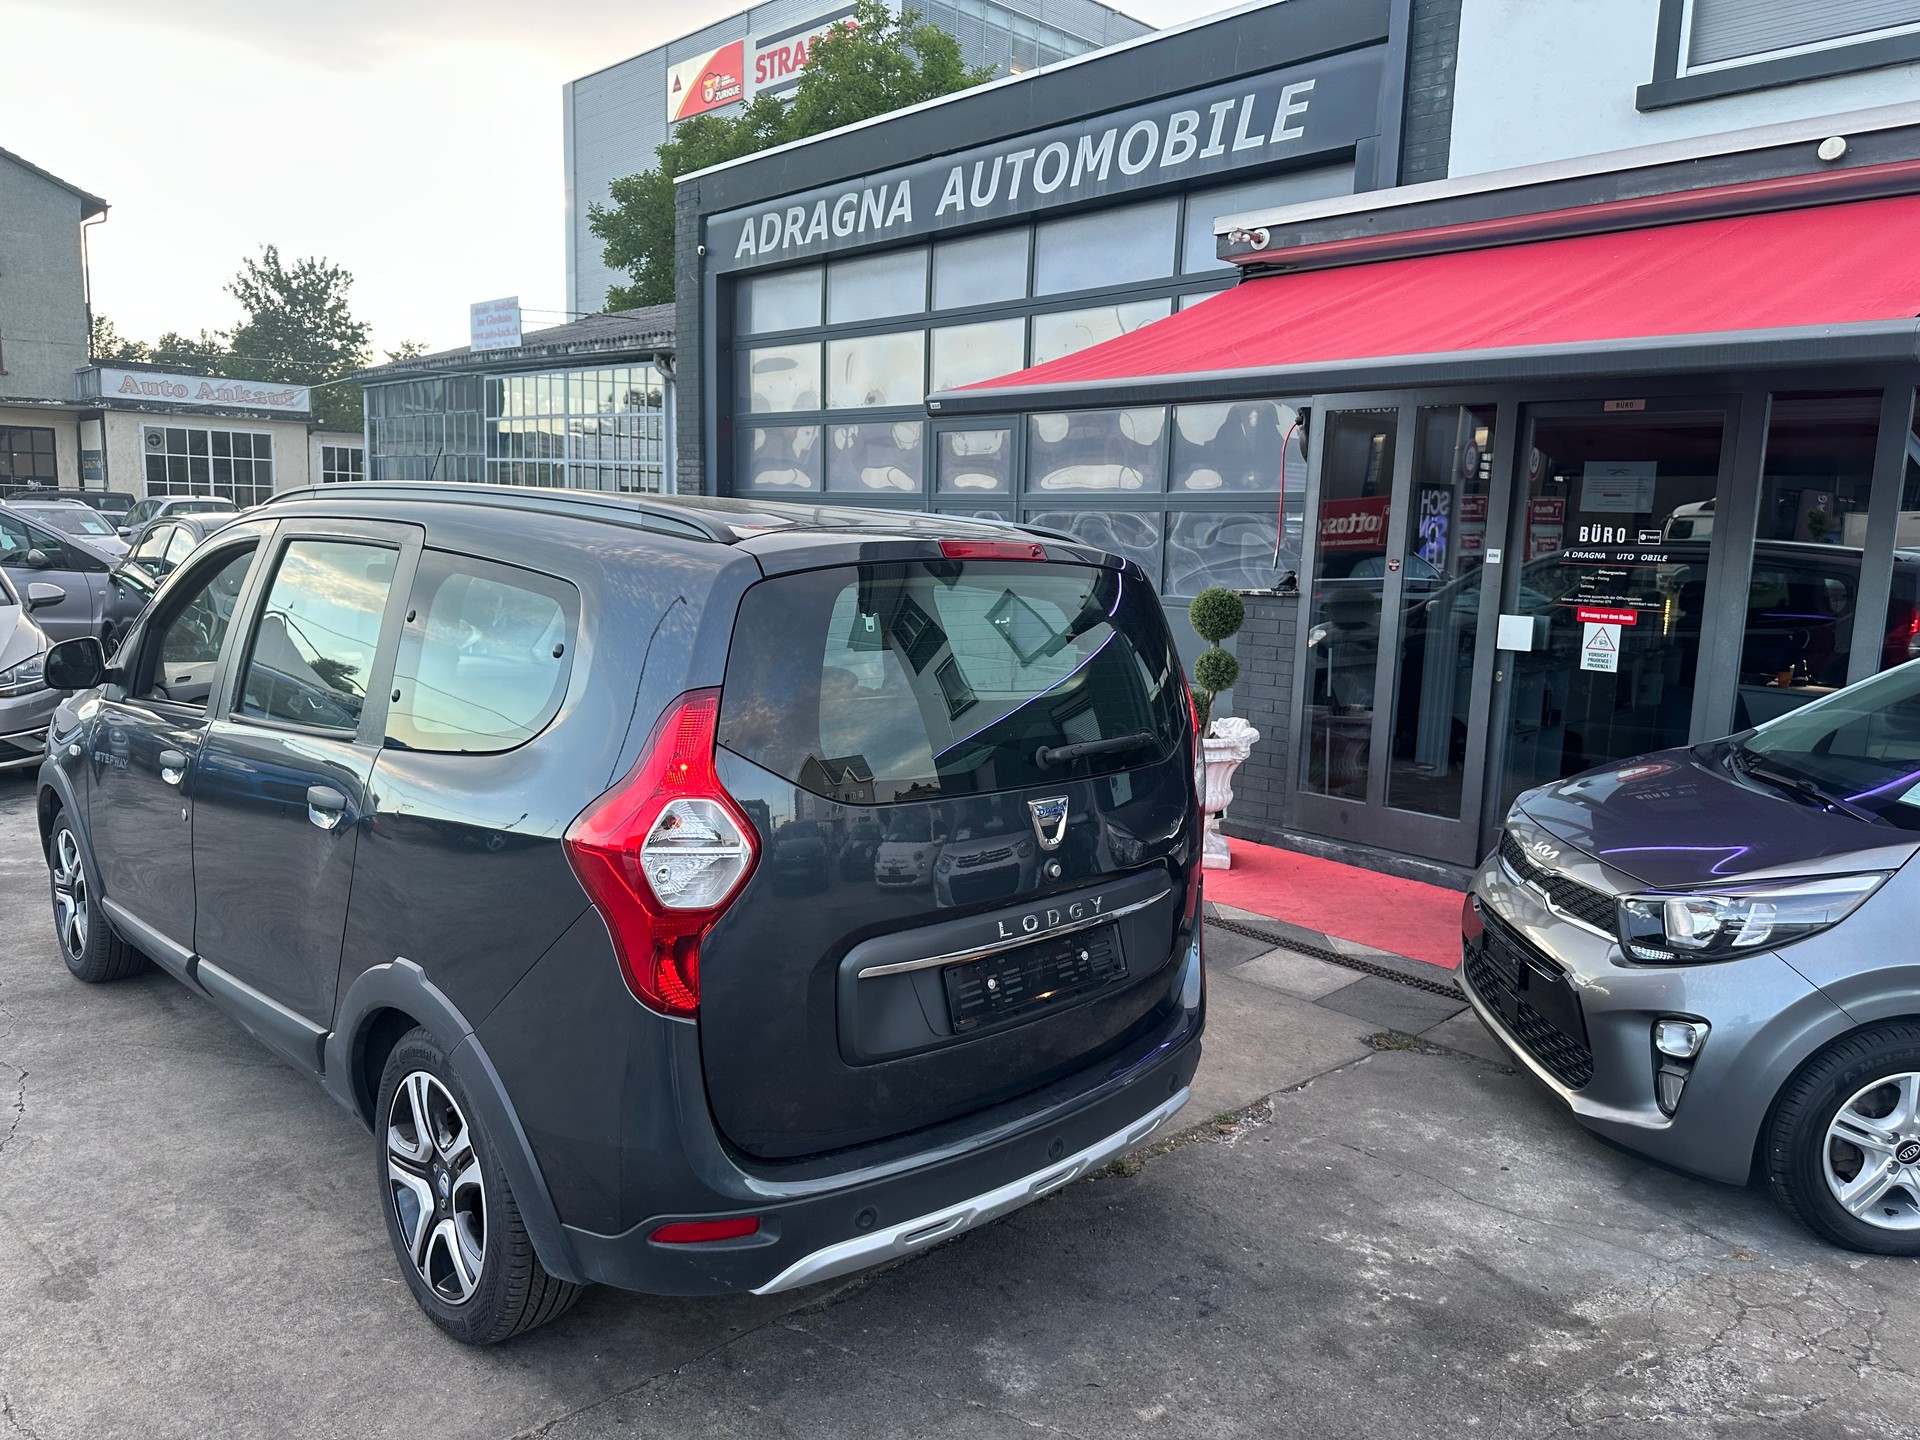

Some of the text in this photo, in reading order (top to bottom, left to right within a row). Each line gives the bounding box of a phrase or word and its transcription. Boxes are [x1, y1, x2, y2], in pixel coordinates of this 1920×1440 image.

[755, 21, 857, 84] STRA
[715, 84, 740, 101] ZURIQUE
[735, 79, 1317, 260] ADRAGNA AUTOMOBILE
[118, 375, 295, 406] Auto Ankauf
[1579, 523, 1626, 544] BÜRO
[1572, 551, 1606, 559] DRAGNA
[1640, 554, 1669, 562] OBILE
[1580, 611, 1601, 620] Warnung
[94, 750, 129, 770] STEPWAY
[1533, 841, 1560, 860] KIA
[998, 896, 1103, 939] LODGY
